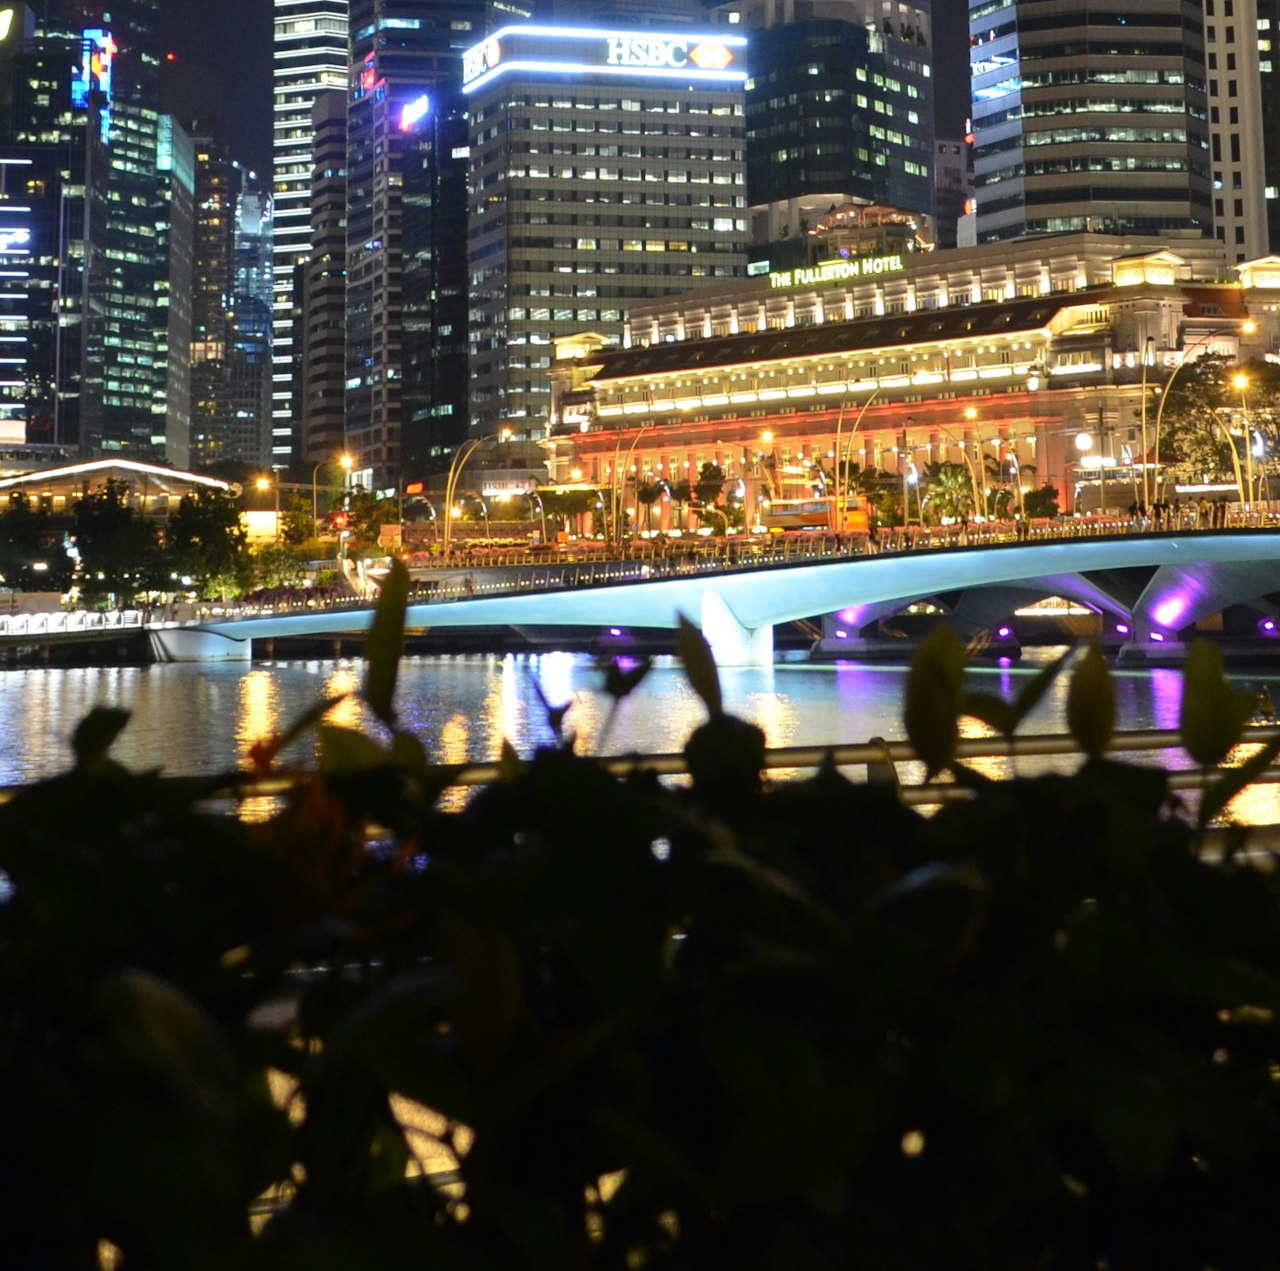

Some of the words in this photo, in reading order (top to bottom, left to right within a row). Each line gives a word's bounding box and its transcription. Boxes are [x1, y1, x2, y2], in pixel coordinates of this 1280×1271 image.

[607, 38, 688, 66] HSBC
[769, 271, 792, 288] THE
[794, 261, 859, 285] FULLERTON
[862, 254, 904, 274] HOTEL
